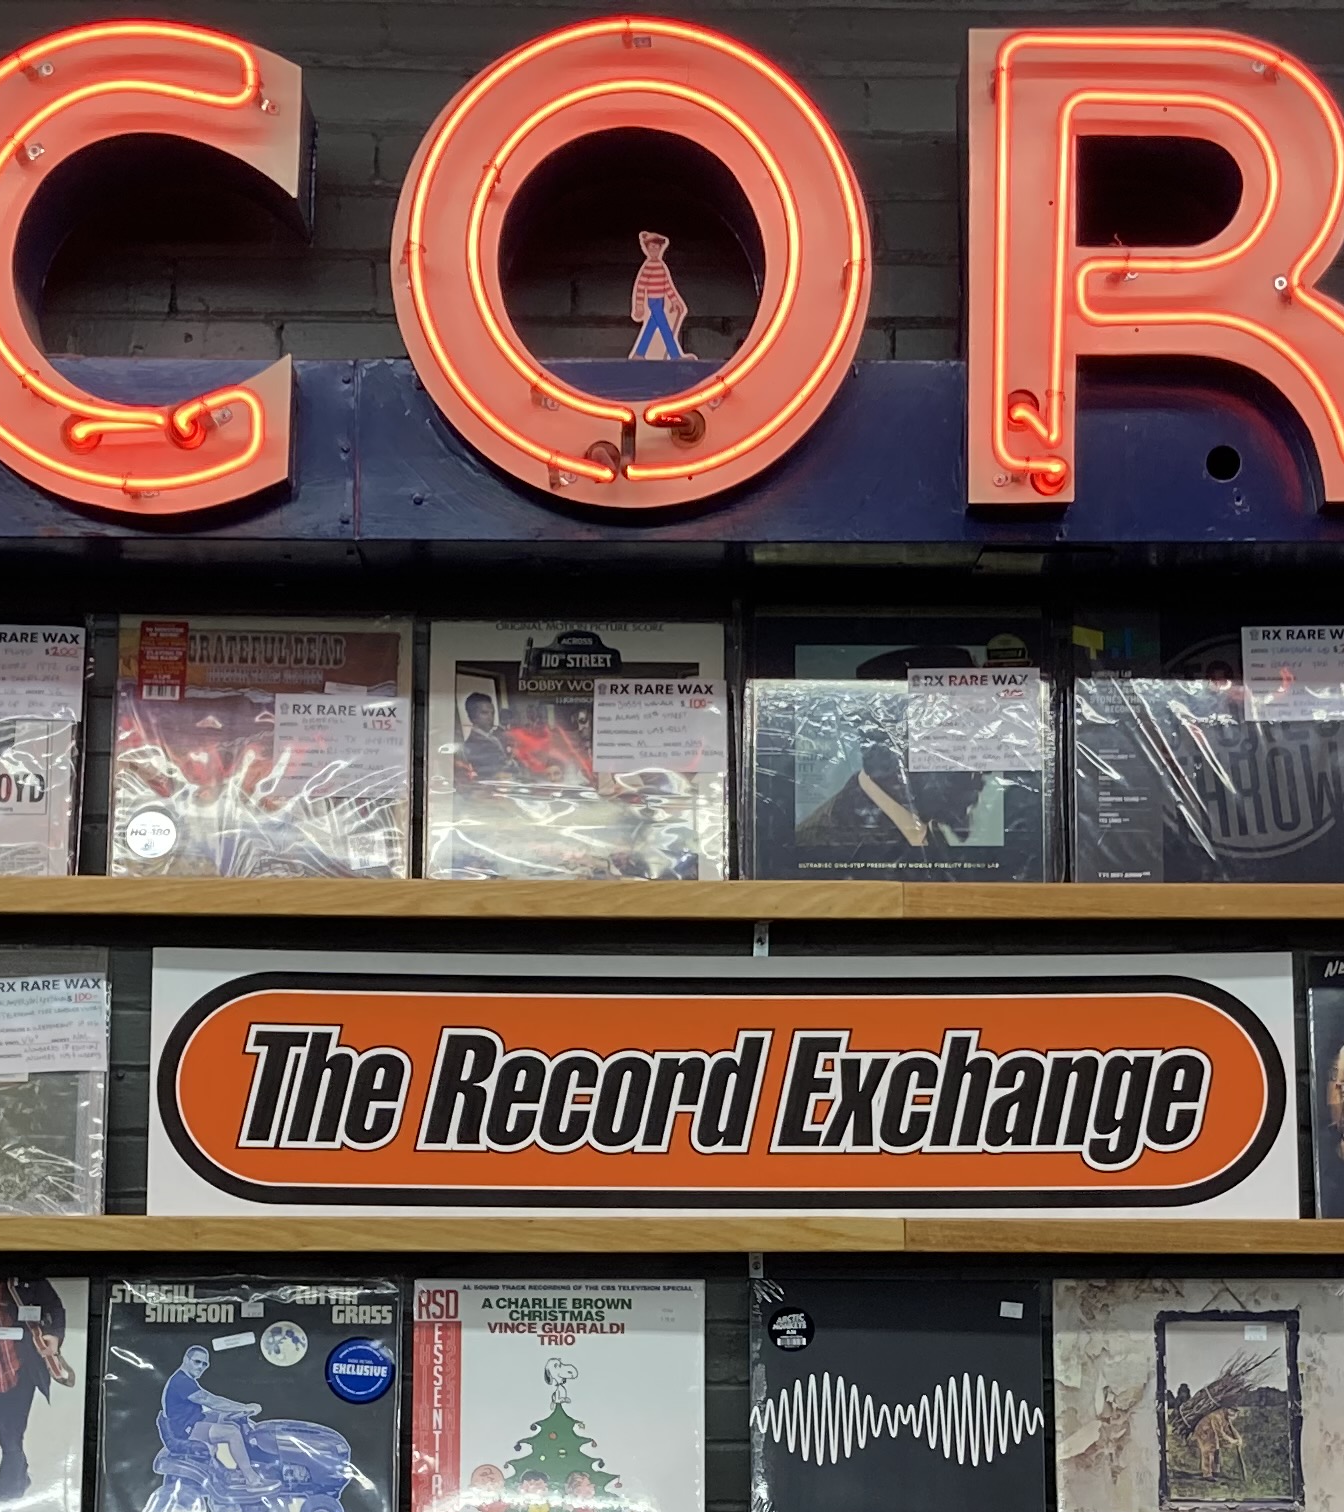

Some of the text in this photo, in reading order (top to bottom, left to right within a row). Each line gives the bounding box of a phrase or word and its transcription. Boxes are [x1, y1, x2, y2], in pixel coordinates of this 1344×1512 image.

[1263, 630, 1281, 640] RX
[1286, 630, 1325, 640] RARE
[561, 637, 593, 646] ACROSS
[566, 653, 613, 668] STREET
[240, 1023, 408, 1150] The
[417, 1025, 772, 1154] Record
[771, 1028, 1210, 1172] Exchange
[482, 1298, 632, 1310] A CHARLIE BROWN
[146, 1305, 234, 1322] SIMPSON
[332, 1306, 393, 1323] GRASS
[511, 1310, 605, 1321] CHRISTMAS
[487, 1322, 625, 1334] VINCE GUARALDI
[538, 1334, 576, 1345] TRIO
[333, 1363, 387, 1377] EXCLUSIVE
